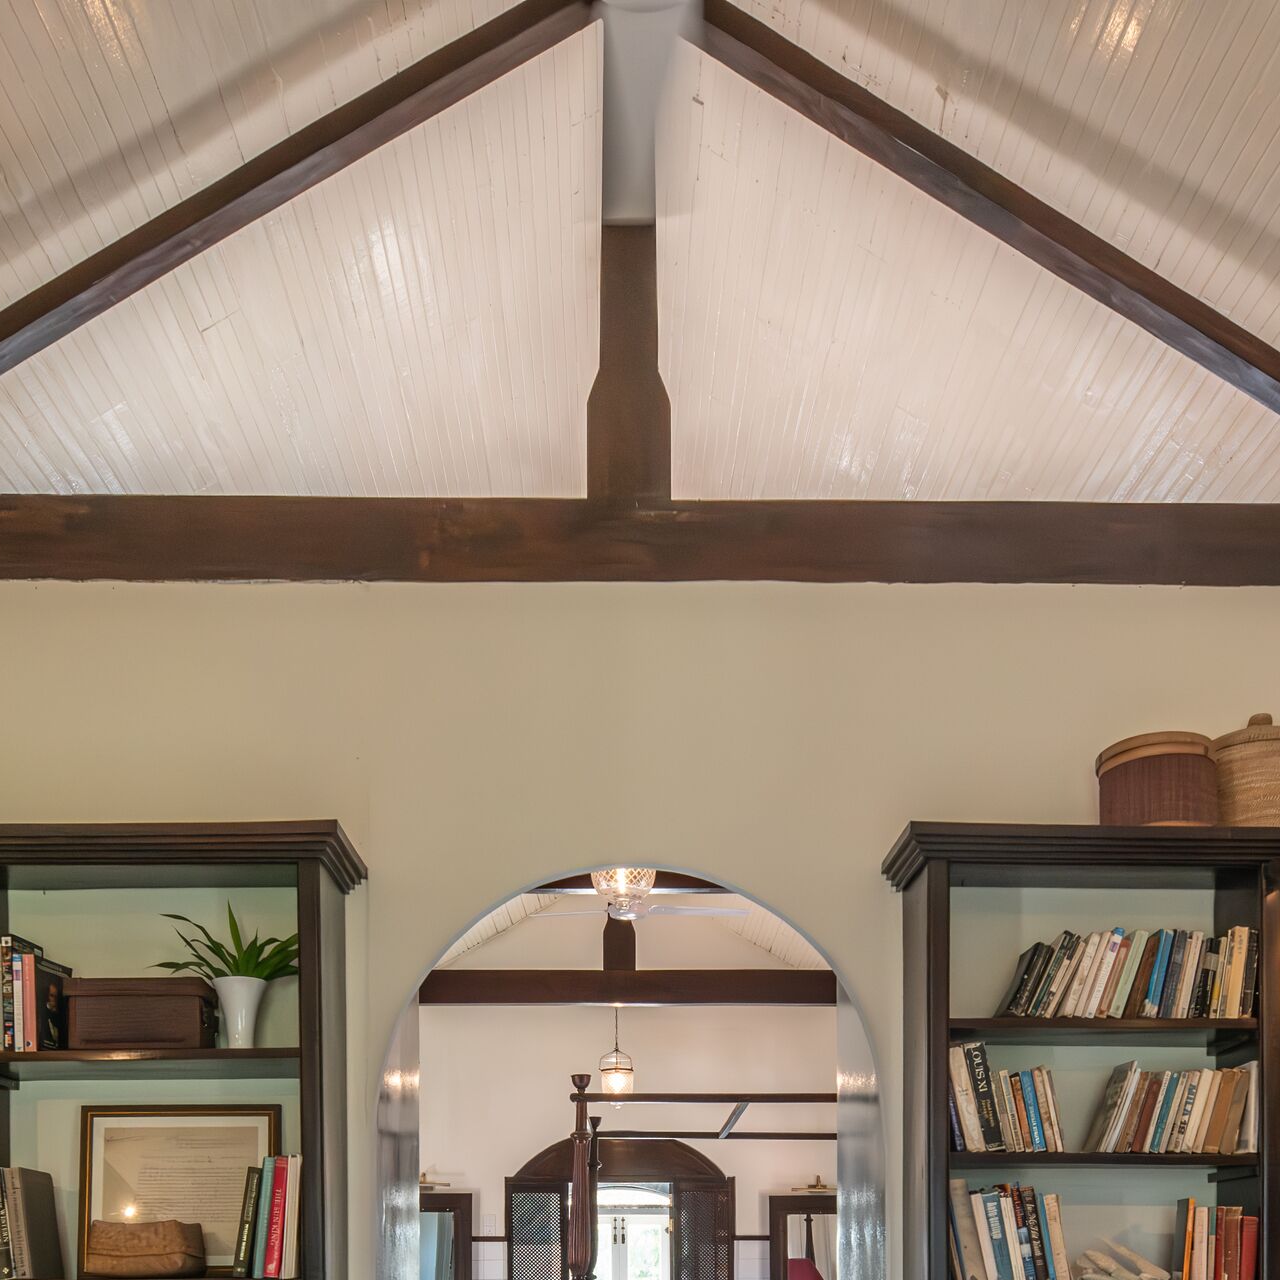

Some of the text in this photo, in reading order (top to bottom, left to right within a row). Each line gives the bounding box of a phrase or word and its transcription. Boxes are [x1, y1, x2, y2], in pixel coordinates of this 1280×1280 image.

[971, 1047, 988, 1093] LOUIS XI
[268, 1224, 279, 1246] KING
